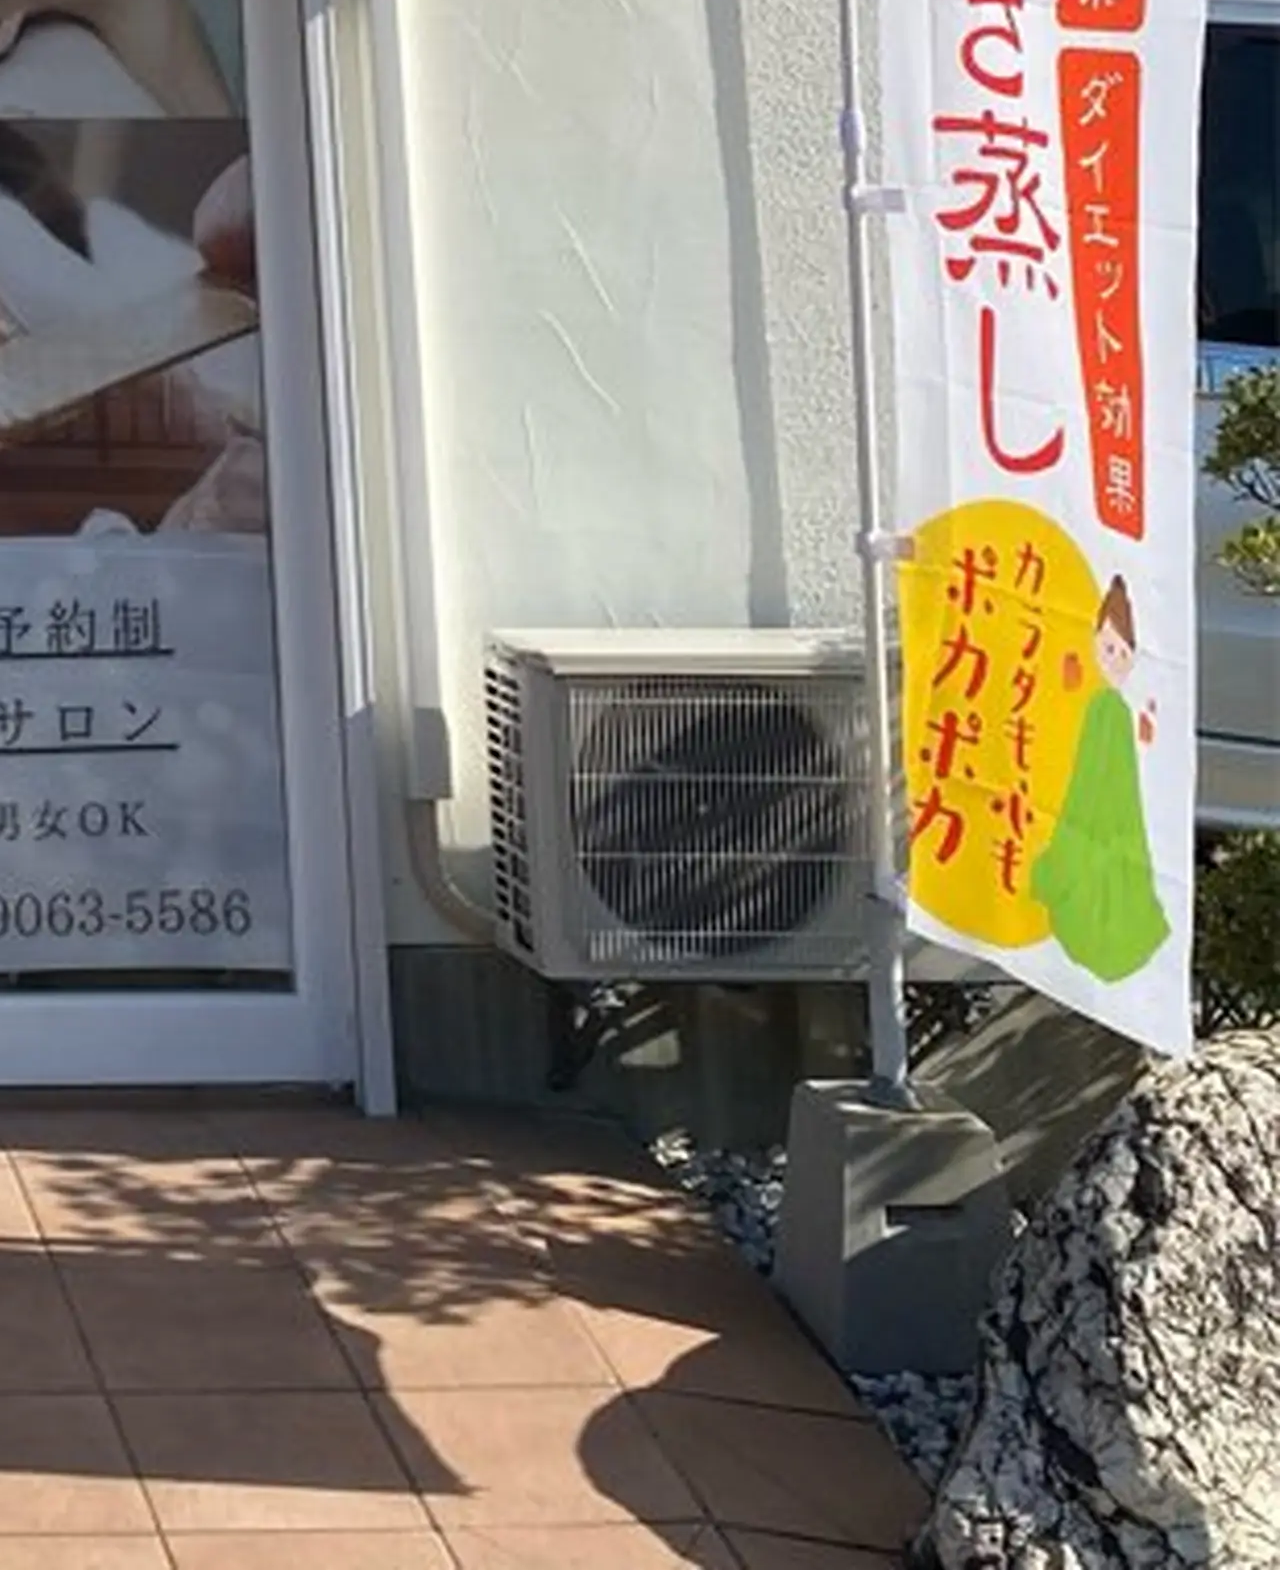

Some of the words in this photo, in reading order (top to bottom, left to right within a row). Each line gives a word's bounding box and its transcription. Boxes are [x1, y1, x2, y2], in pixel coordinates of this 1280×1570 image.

[1079, 72, 1136, 515] ダイエット効果
[909, 546, 997, 864] ポカポカ
